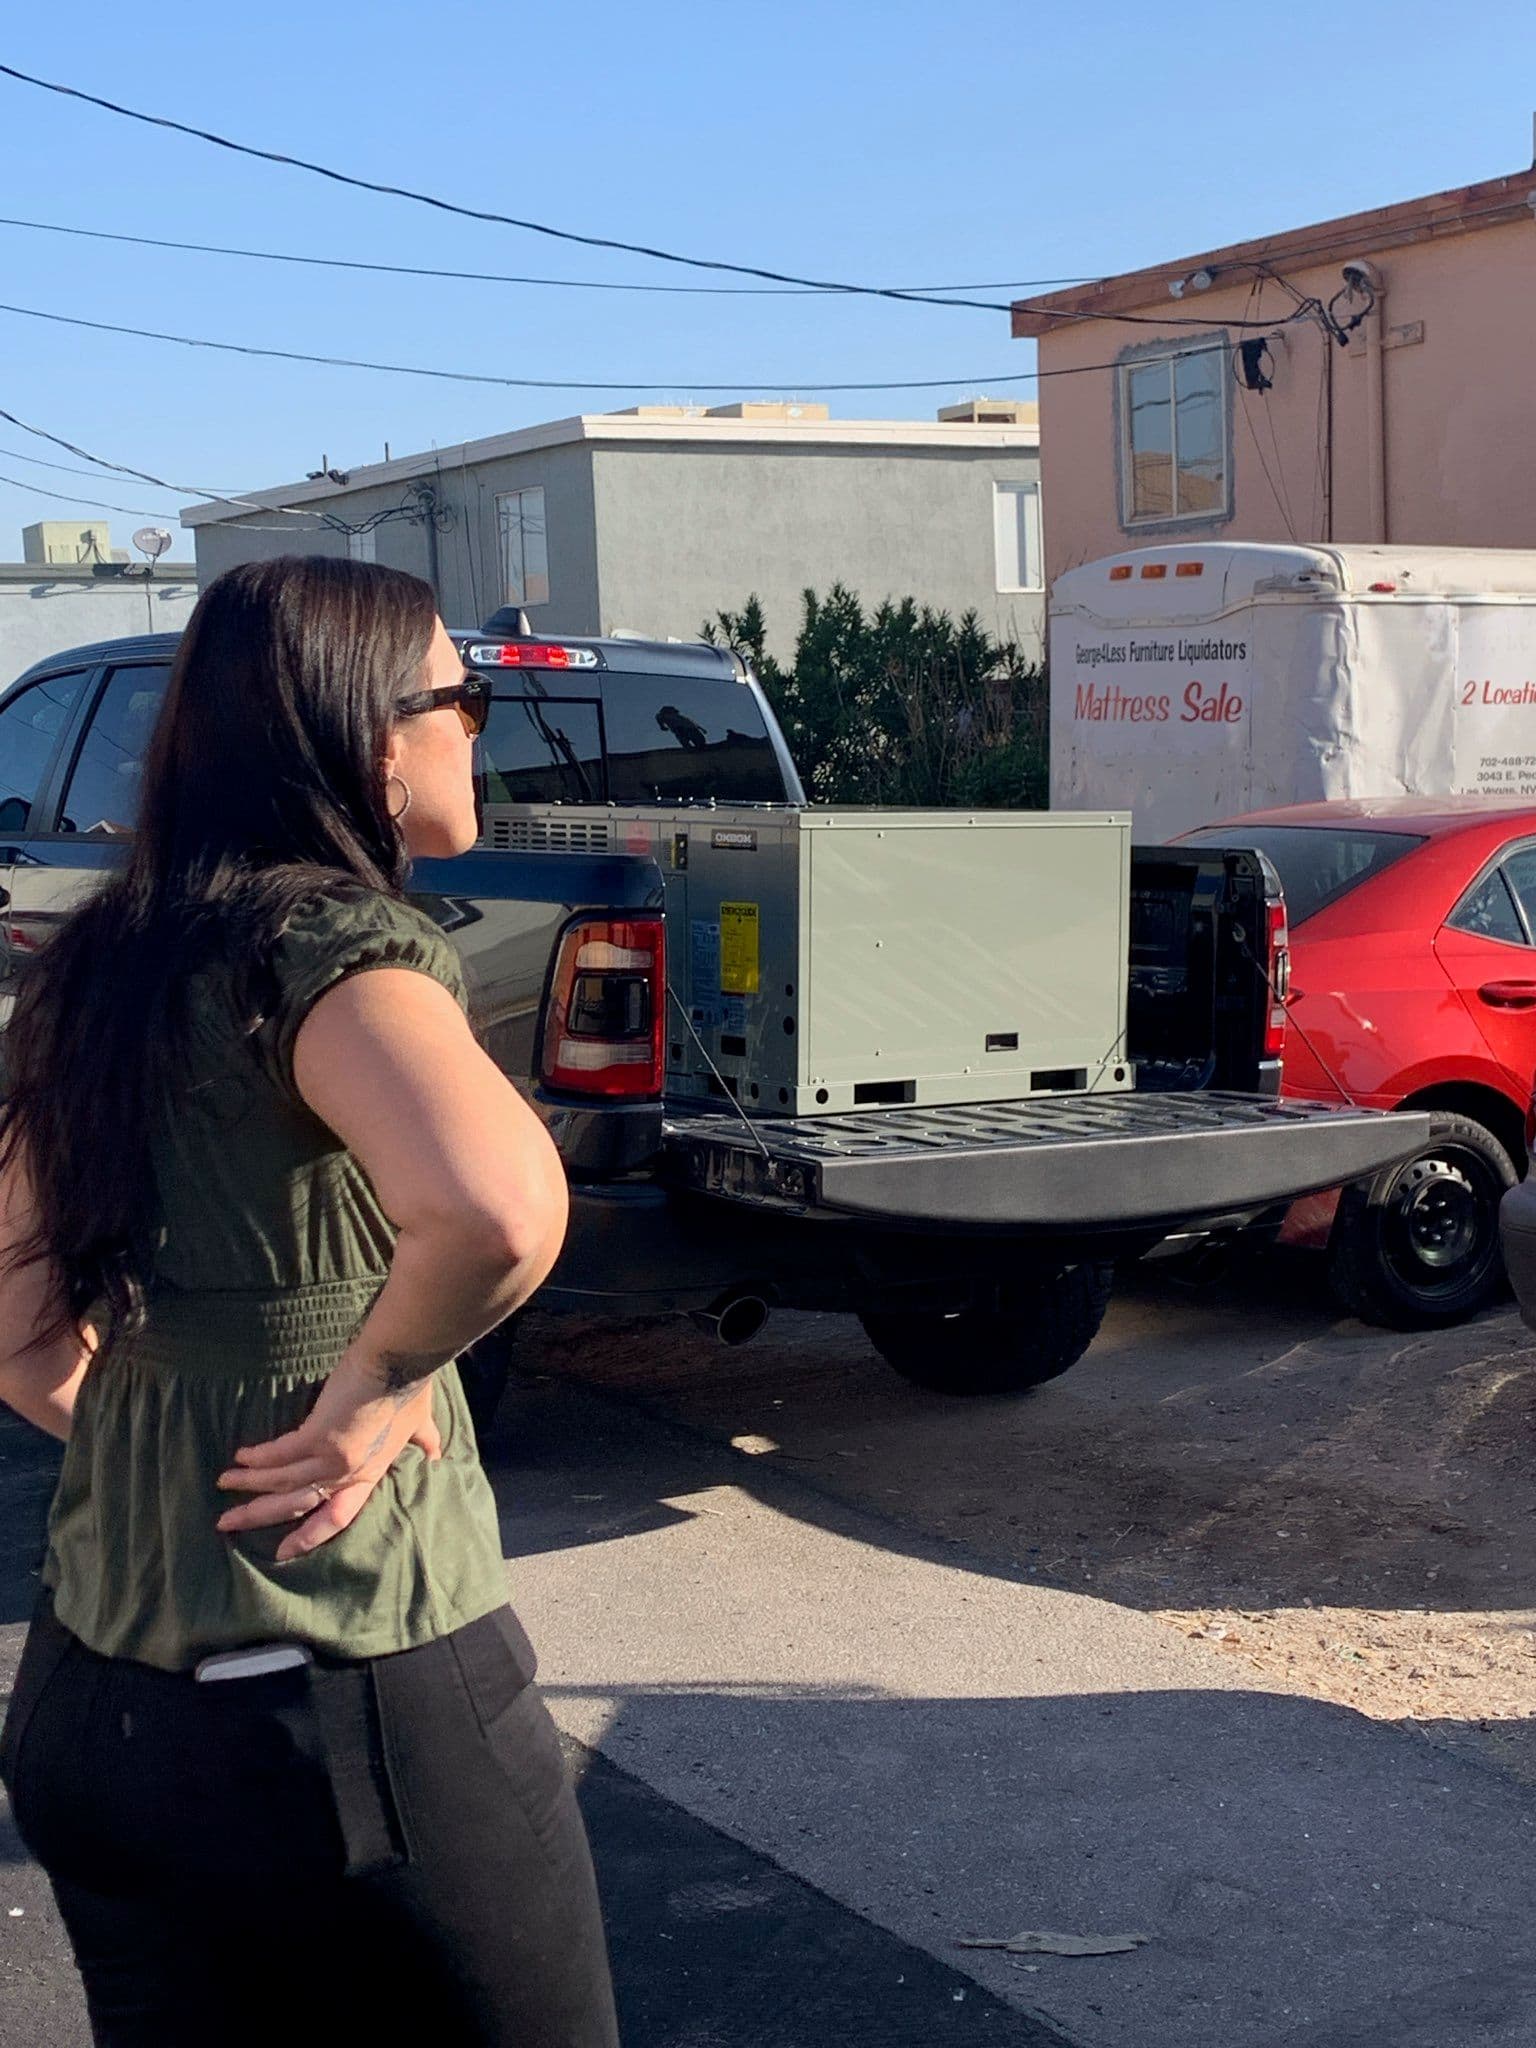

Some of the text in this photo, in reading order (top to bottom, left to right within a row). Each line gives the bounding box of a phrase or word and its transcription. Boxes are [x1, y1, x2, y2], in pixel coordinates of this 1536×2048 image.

[1129, 641, 1174, 663] Furniture
[1178, 639, 1246, 666] Liquidators
[1075, 681, 1243, 723] Mattress Sale
[1461, 680, 1536, 704] 2 Locati
[1476, 771, 1503, 782] 3043
